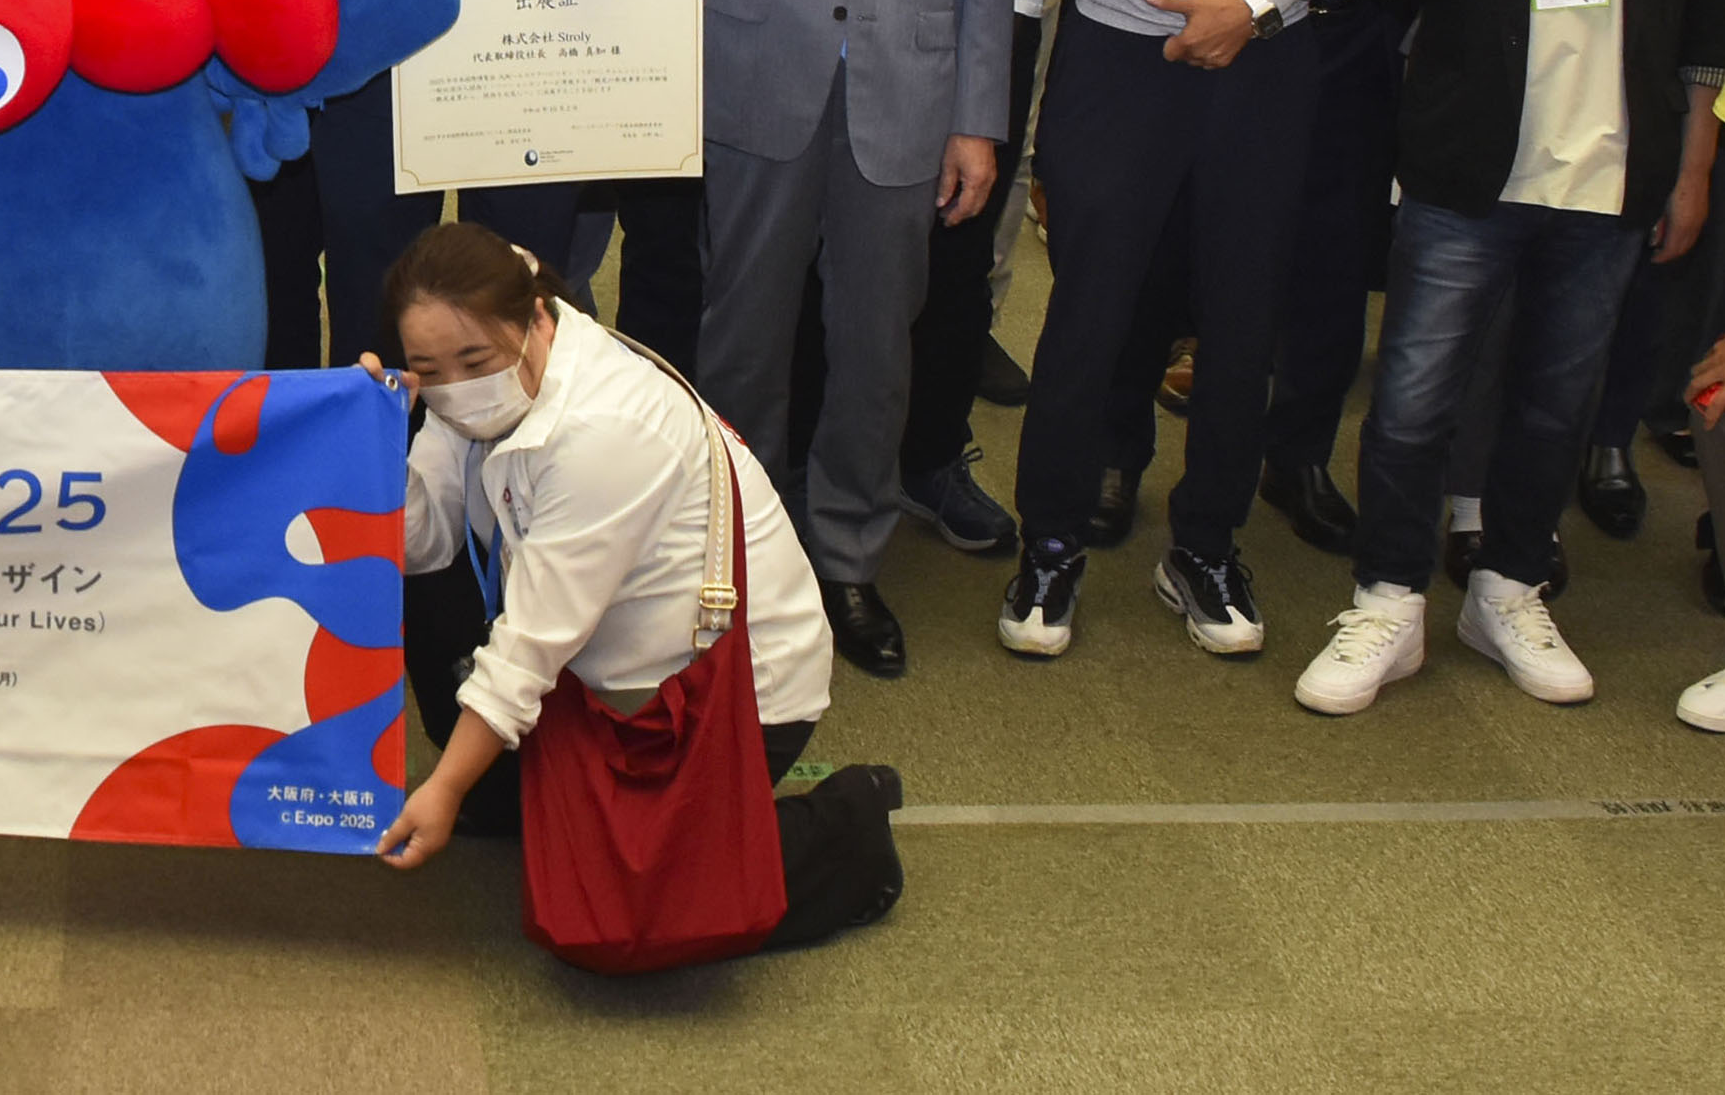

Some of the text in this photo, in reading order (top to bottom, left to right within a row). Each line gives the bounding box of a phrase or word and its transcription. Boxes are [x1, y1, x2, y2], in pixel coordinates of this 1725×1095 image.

[502, 30, 591, 46] 株式会社 Stroly
[30, 610, 106, 633] Lives)
[267, 785, 375, 807] 大阪府・大阪市
[295, 809, 335, 827] Expo
[339, 813, 376, 830] 2025
